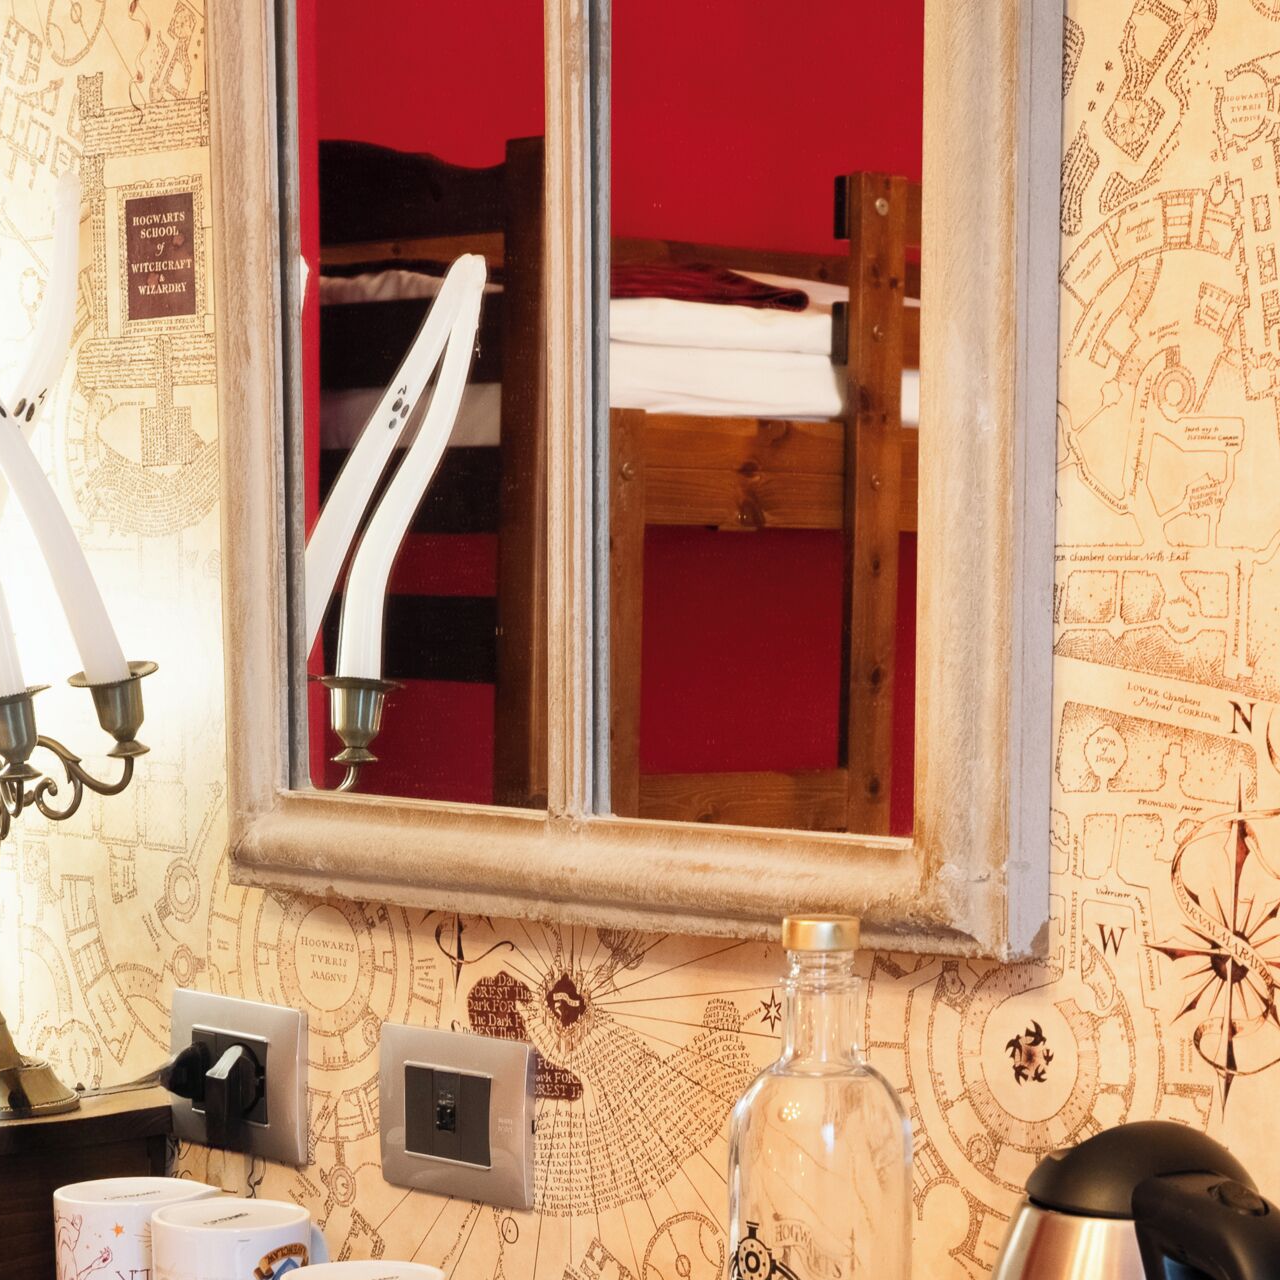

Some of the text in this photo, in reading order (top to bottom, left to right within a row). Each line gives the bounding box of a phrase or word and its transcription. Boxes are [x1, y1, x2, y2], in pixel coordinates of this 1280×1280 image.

[132, 211, 185, 227] HOGWARTS
[140, 226, 179, 239] SCHOOL
[131, 259, 193, 274] WITCHCRAFT
[138, 282, 187, 295] WIZARDRY
[1228, 700, 1257, 735] N
[301, 936, 355, 953] HOGWARTS
[1096, 923, 1129, 957] W
[488, 1013, 513, 1025] Dark
[535, 1086, 568, 1097] OREST
